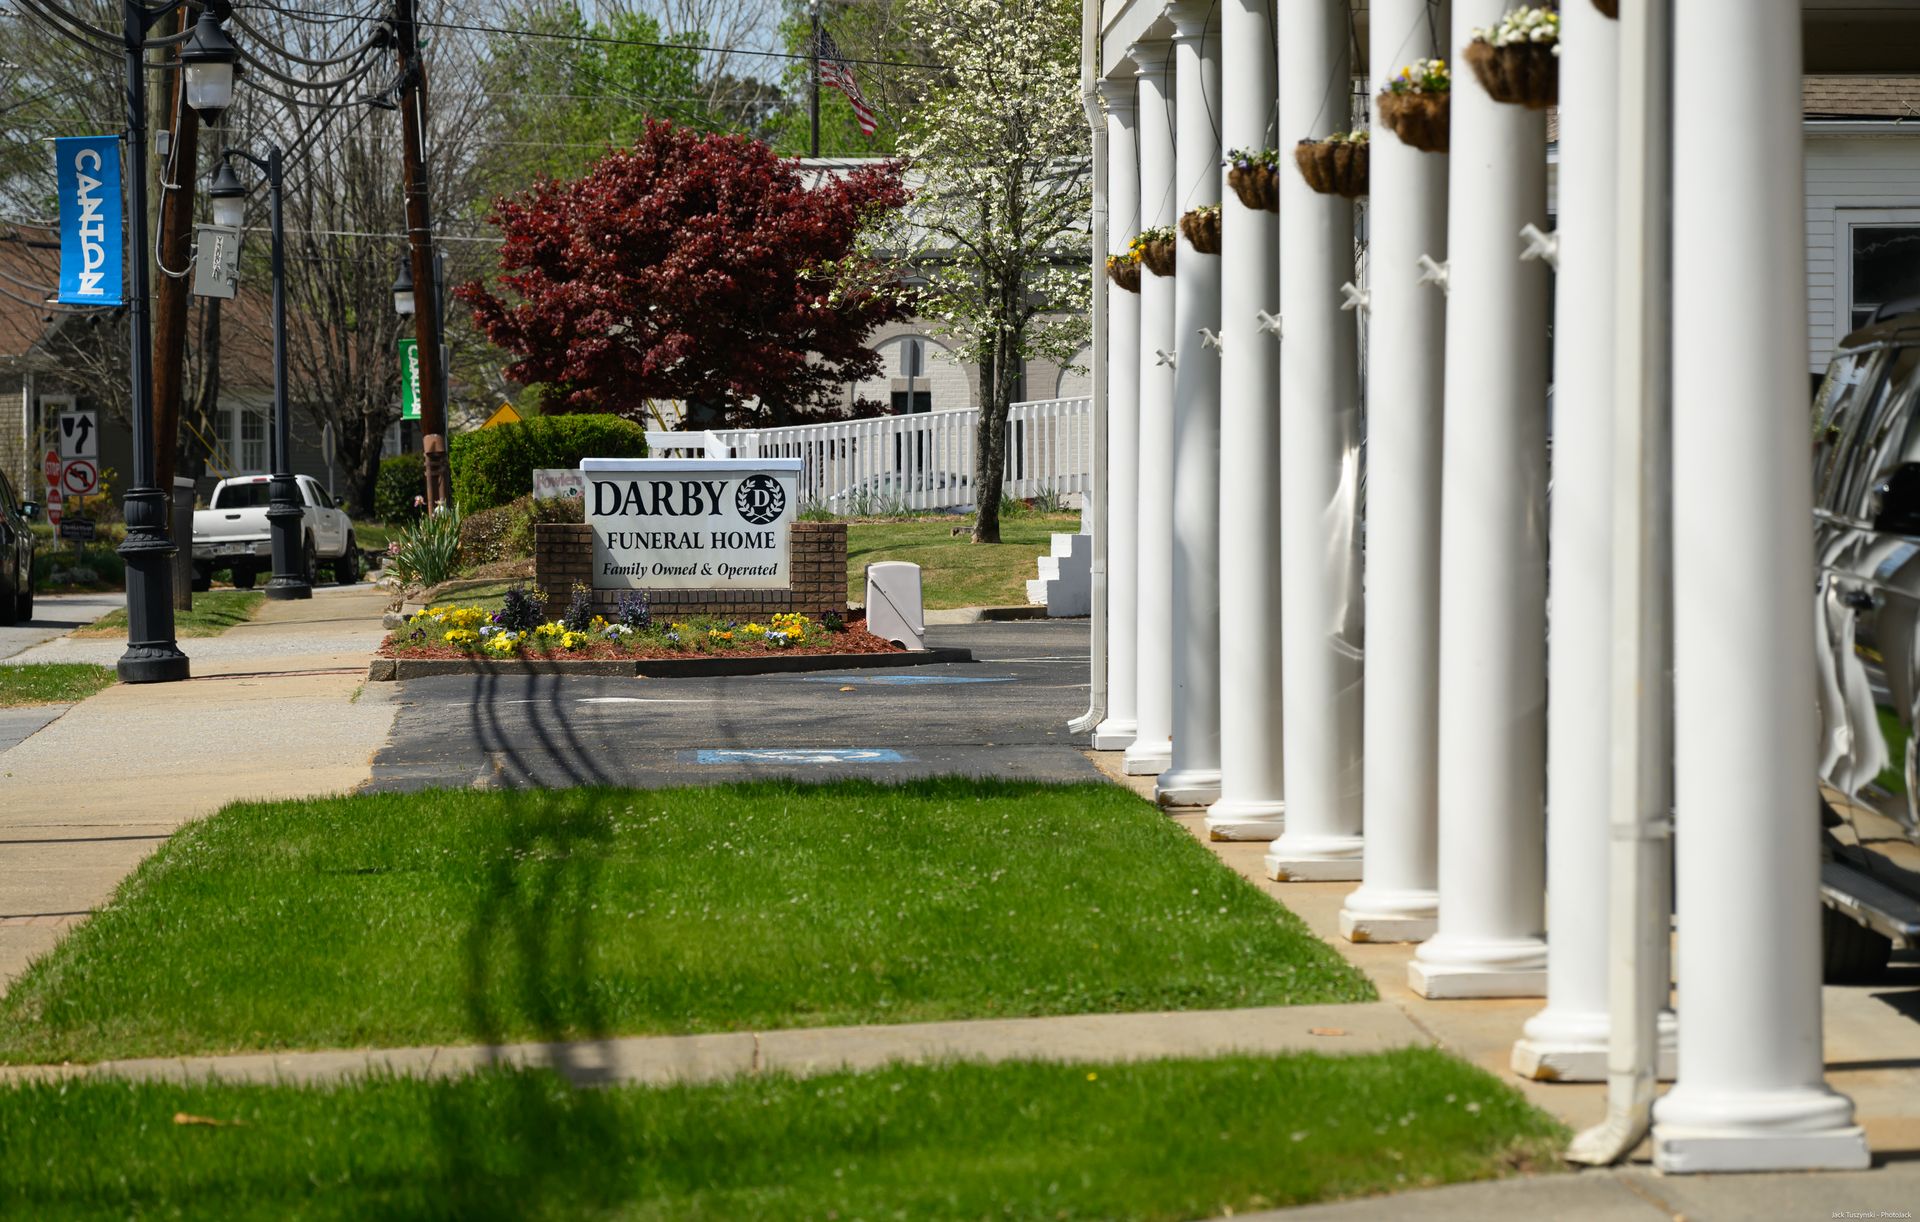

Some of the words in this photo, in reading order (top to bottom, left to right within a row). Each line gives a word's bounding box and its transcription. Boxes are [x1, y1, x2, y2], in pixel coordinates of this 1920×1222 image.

[75, 148, 105, 295] CANTON
[46, 461, 60, 477] STOP
[592, 480, 729, 517] DARBY
[753, 489, 771, 508] D
[607, 531, 705, 550] FUNERAL
[711, 531, 776, 550] HOME
[603, 562, 648, 580] Family
[651, 562, 698, 577] Owned
[700, 562, 713, 577] &
[717, 562, 778, 580] Operated
